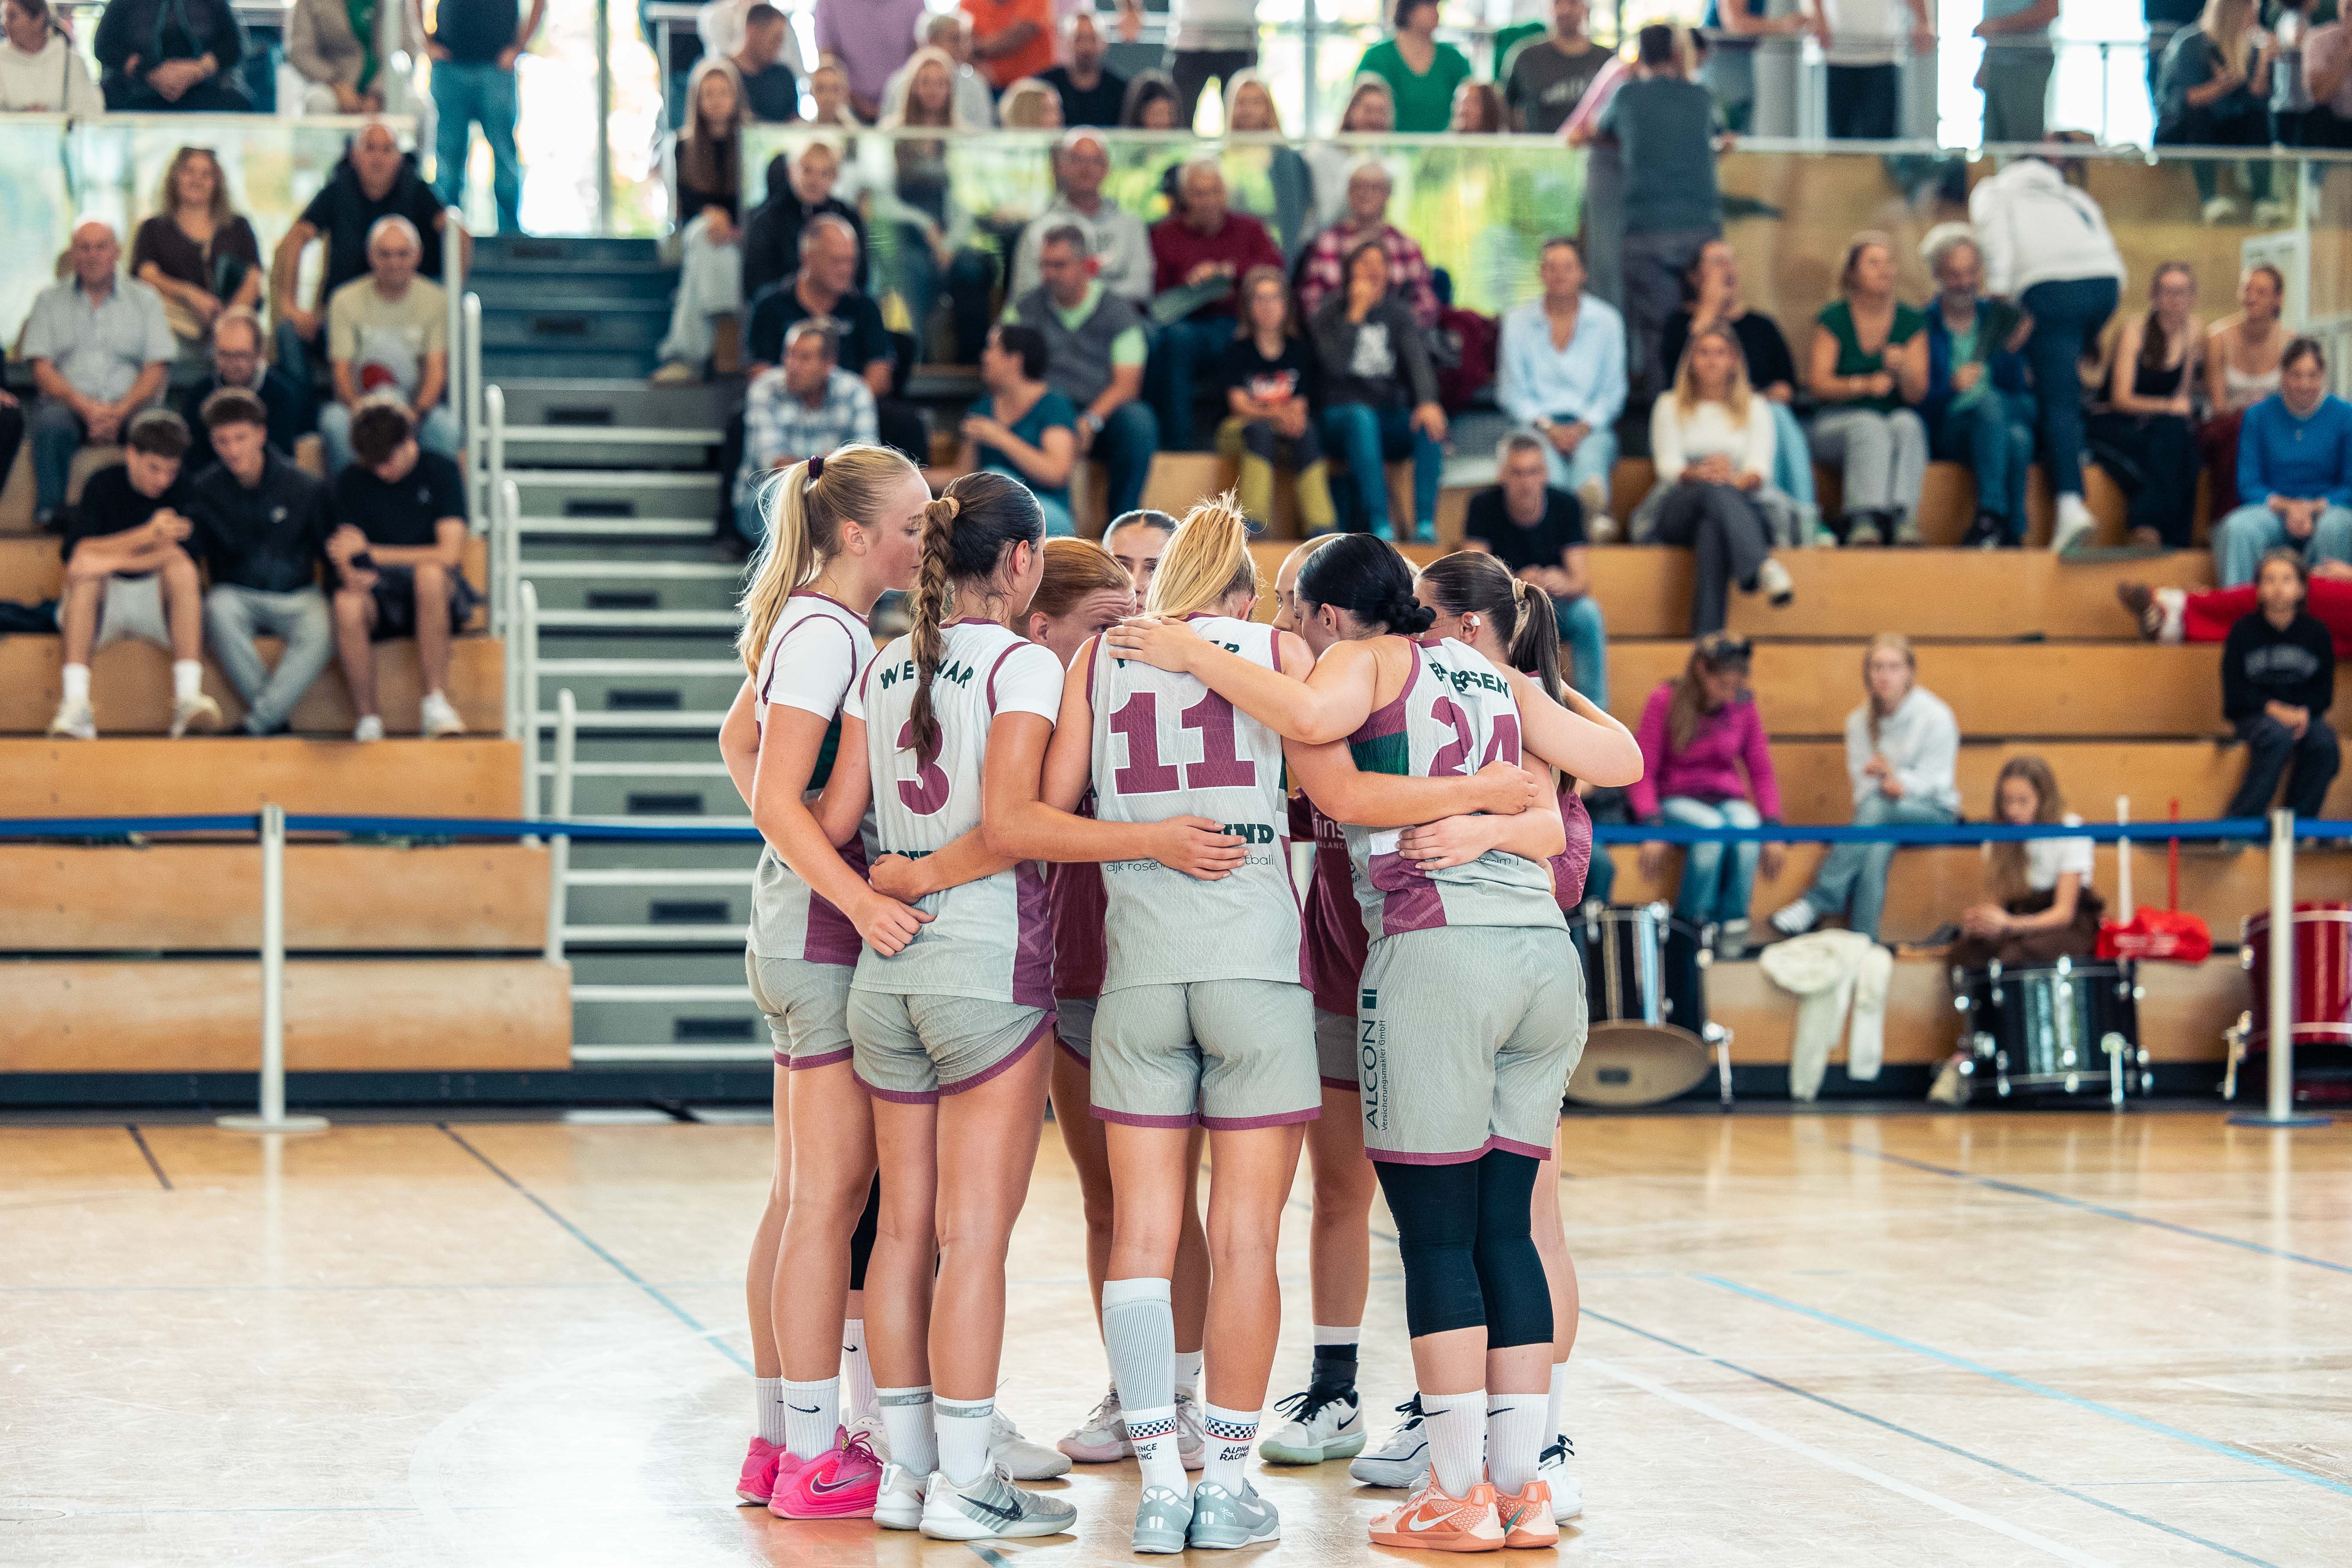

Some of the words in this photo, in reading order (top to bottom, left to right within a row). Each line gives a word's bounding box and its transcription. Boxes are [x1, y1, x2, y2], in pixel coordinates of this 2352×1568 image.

[880, 660, 974, 690] WEAR
[895, 715, 950, 816] 3
[1109, 688, 1256, 795] 11
[1427, 696, 1520, 777] 24
[1106, 861, 1124, 874] djk
[1128, 861, 1166, 871] rosen
[1243, 854, 1274, 865] tball
[1362, 1019, 1378, 1130] ALCON
[1380, 1048, 1388, 1131] Versicherungsmakler
[1219, 1450, 1249, 1461] RACING
[1223, 1445, 1250, 1454] ALPHA
